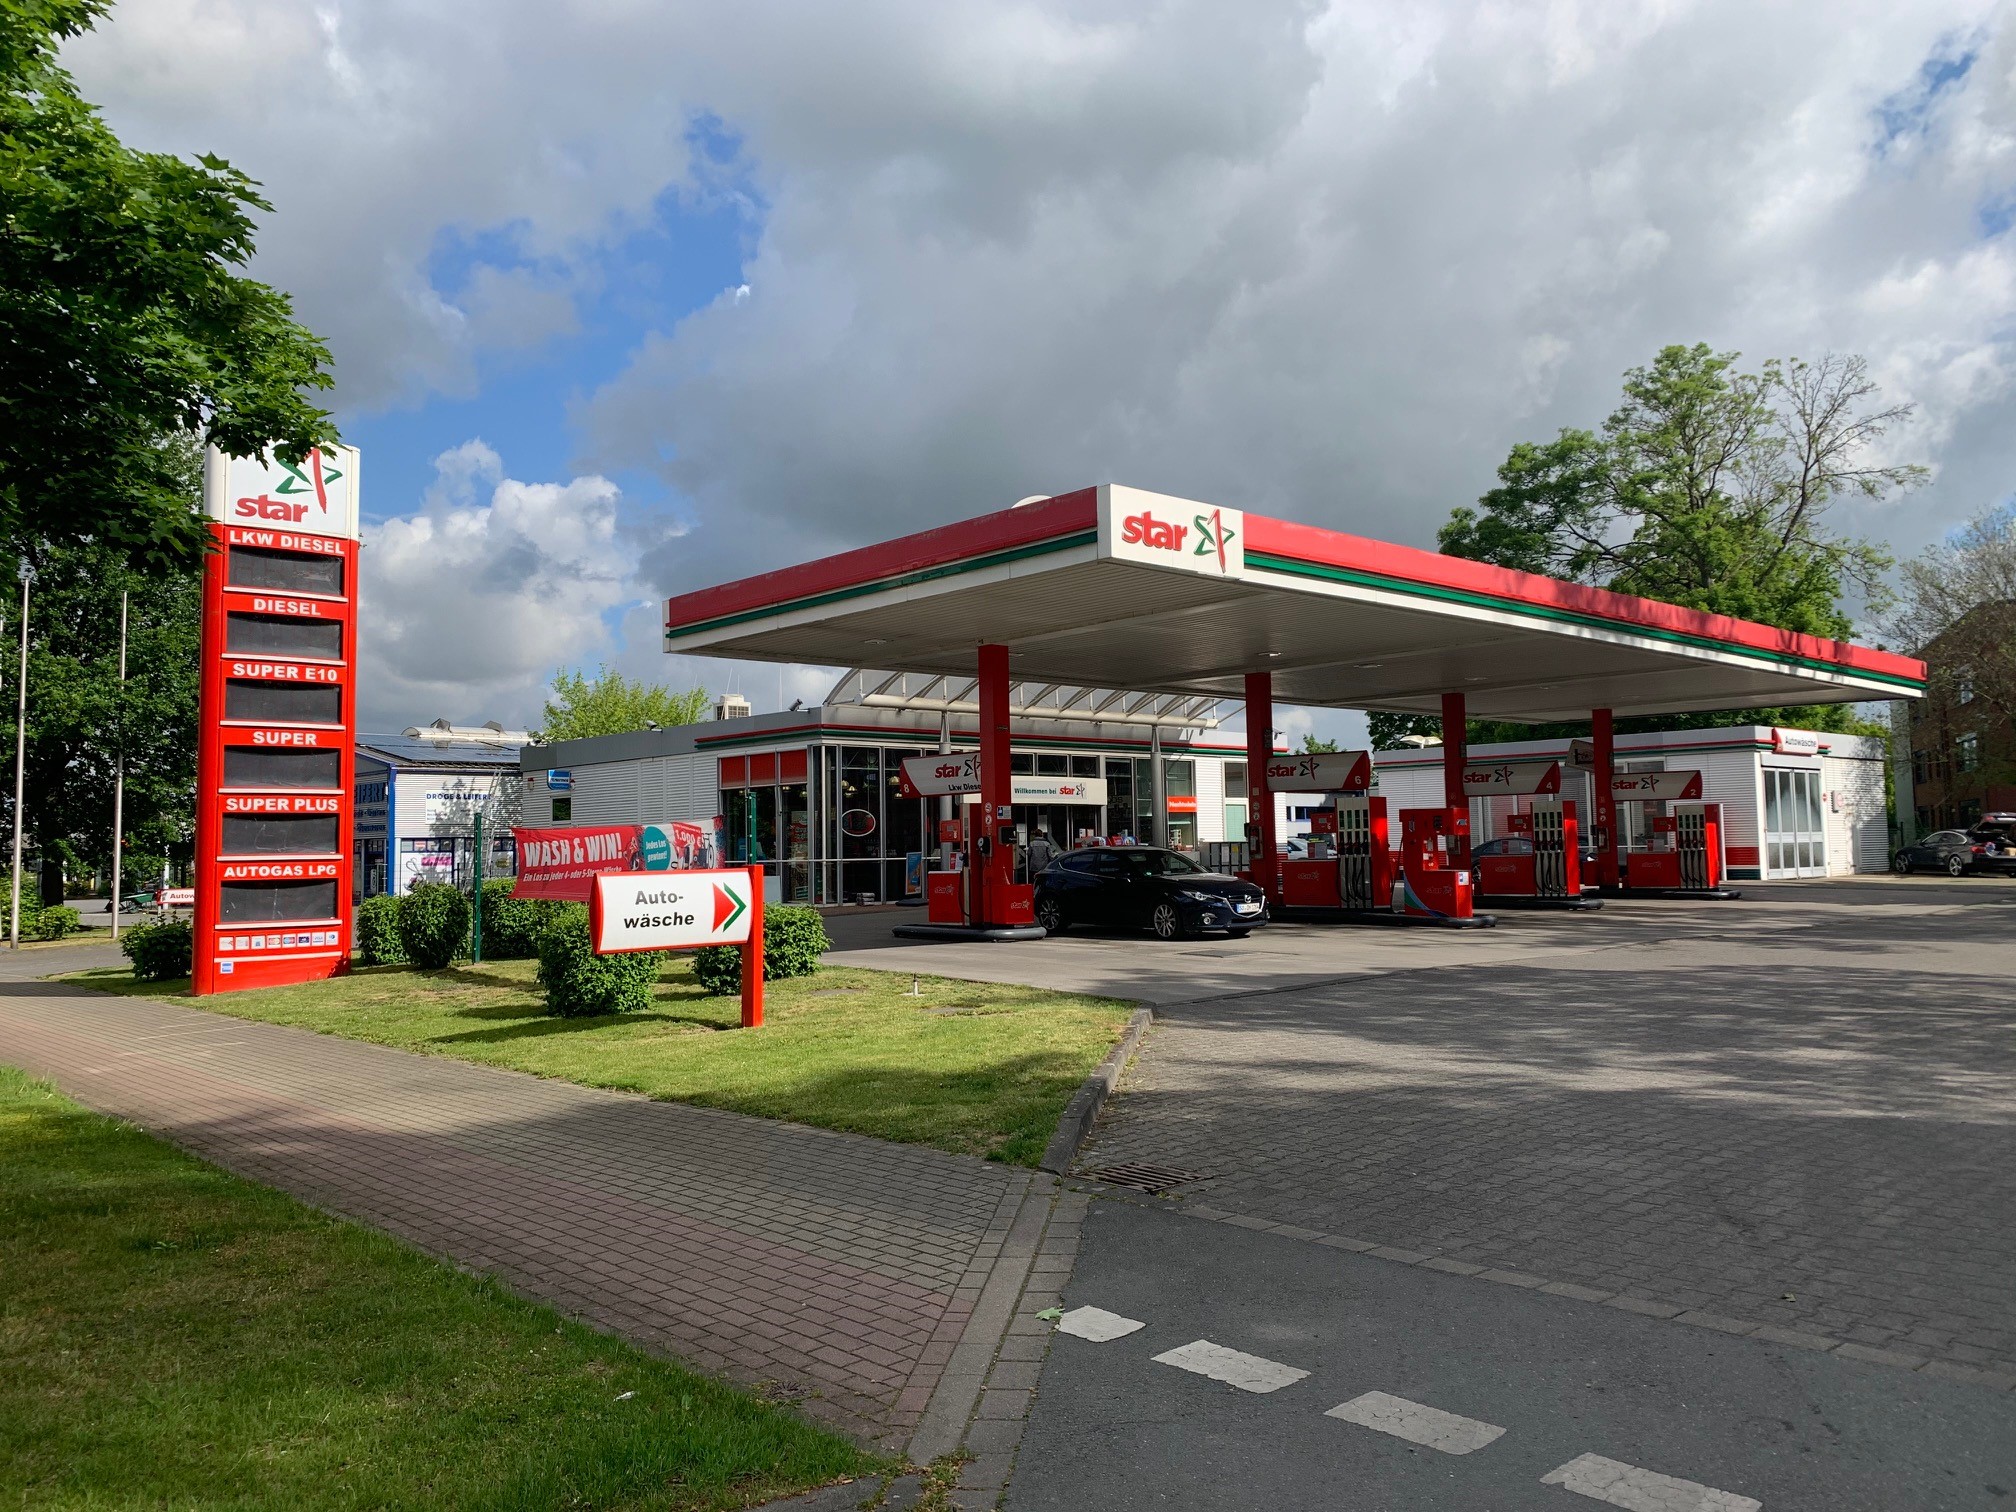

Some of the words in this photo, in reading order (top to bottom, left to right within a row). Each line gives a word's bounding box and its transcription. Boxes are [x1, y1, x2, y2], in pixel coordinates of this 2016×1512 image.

[235, 494, 308, 523] star
[1121, 511, 1188, 551] star
[229, 530, 274, 546] LKW
[280, 535, 345, 555] DIESEL
[253, 598, 321, 616] DIESEL
[232, 663, 299, 679] SUPER
[305, 668, 338, 682] E10
[252, 731, 317, 746] SUPER
[934, 763, 961, 779] star
[1267, 764, 1297, 777] star
[1354, 775, 1362, 785] 6
[1463, 771, 1491, 784] star
[903, 783, 910, 793] 8
[948, 783, 962, 791] Lkw
[963, 782, 981, 790] Diese
[1014, 787, 1048, 795] Willkommen
[1049, 787, 1057, 795] bei
[1059, 786, 1075, 795] star
[1546, 782, 1553, 790] 4
[1611, 780, 1639, 790] star
[1690, 788, 1697, 796] 2
[226, 798, 289, 811] SUPER
[294, 799, 338, 811] PLUS
[523, 839, 571, 867] WASH
[573, 837, 585, 864] &
[584, 832, 622, 862] WIN!
[224, 866, 303, 877] AUTOGAS
[308, 865, 336, 876] LPG
[523, 872, 533, 882] Ein
[533, 872, 543, 881] Los
[549, 870, 564, 882] jeder
[570, 868, 583, 879] oder
[635, 890, 684, 905] Auto-
[624, 912, 695, 929] wäsche
